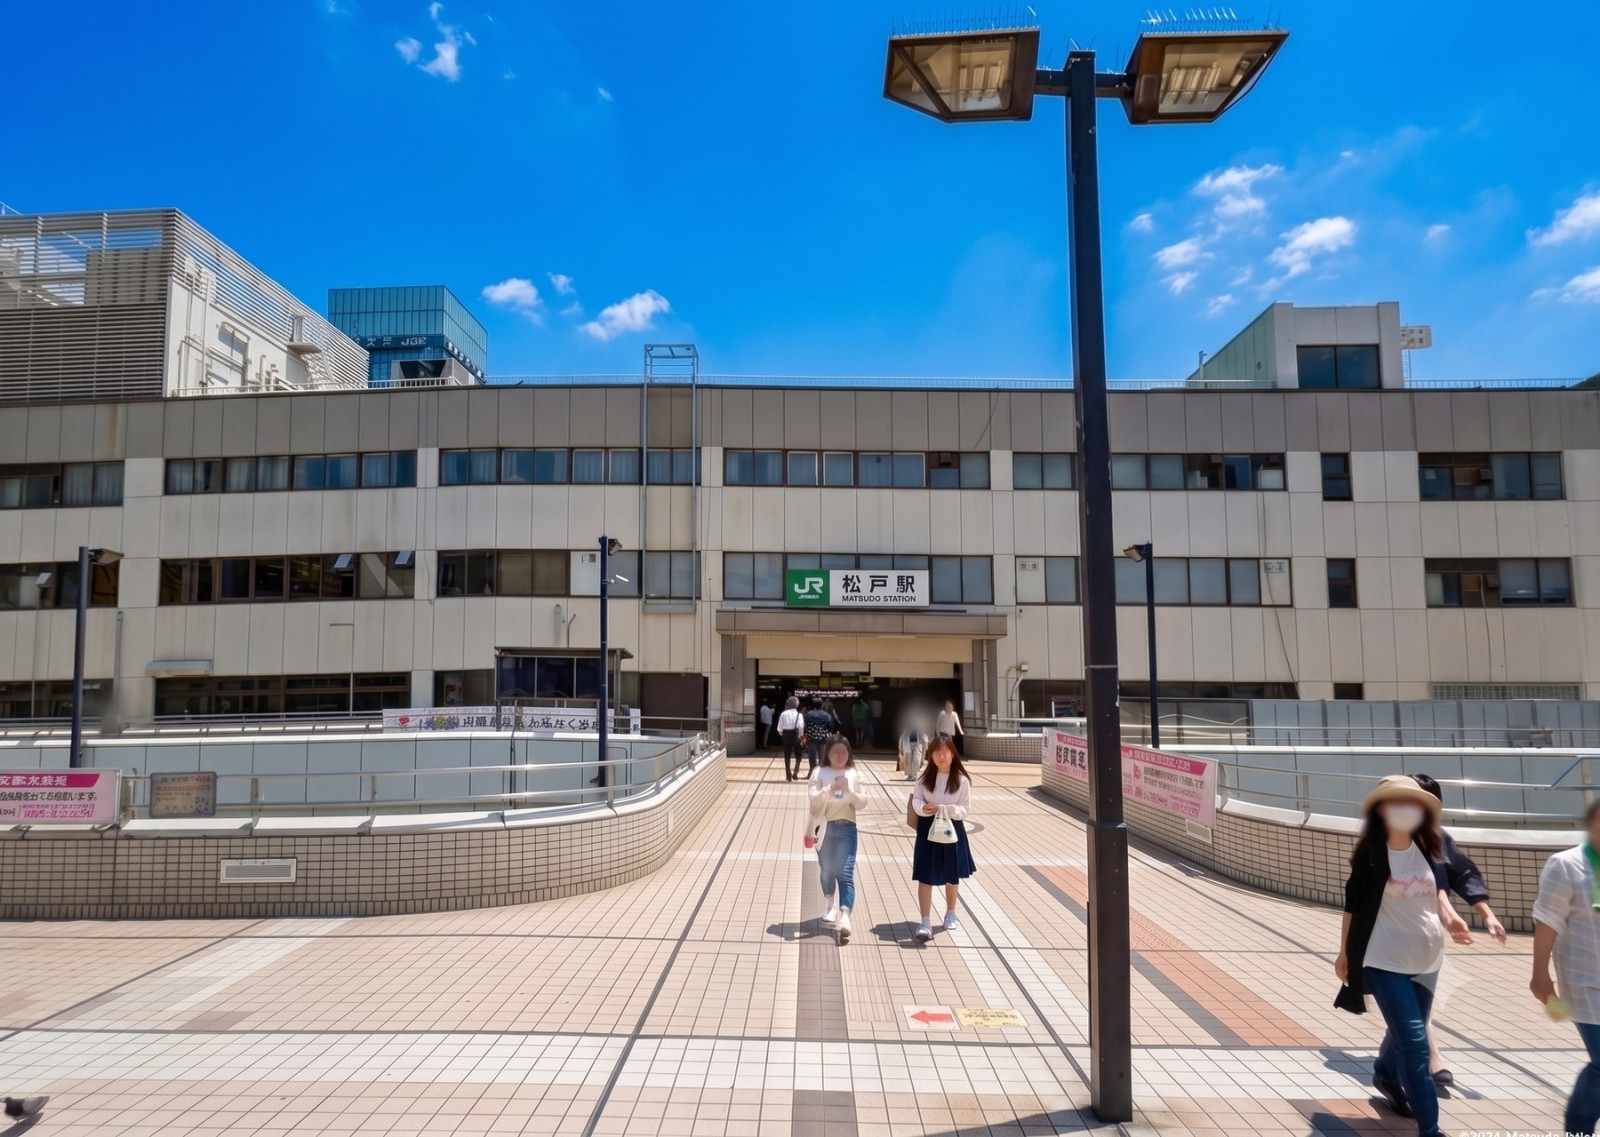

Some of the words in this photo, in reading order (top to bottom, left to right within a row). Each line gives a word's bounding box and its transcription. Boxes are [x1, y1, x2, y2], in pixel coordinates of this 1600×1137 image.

[794, 577, 824, 594] JR
[842, 574, 915, 594] 松戸駅
[841, 595, 881, 603] MATSUDO
[883, 595, 916, 603] STATION
